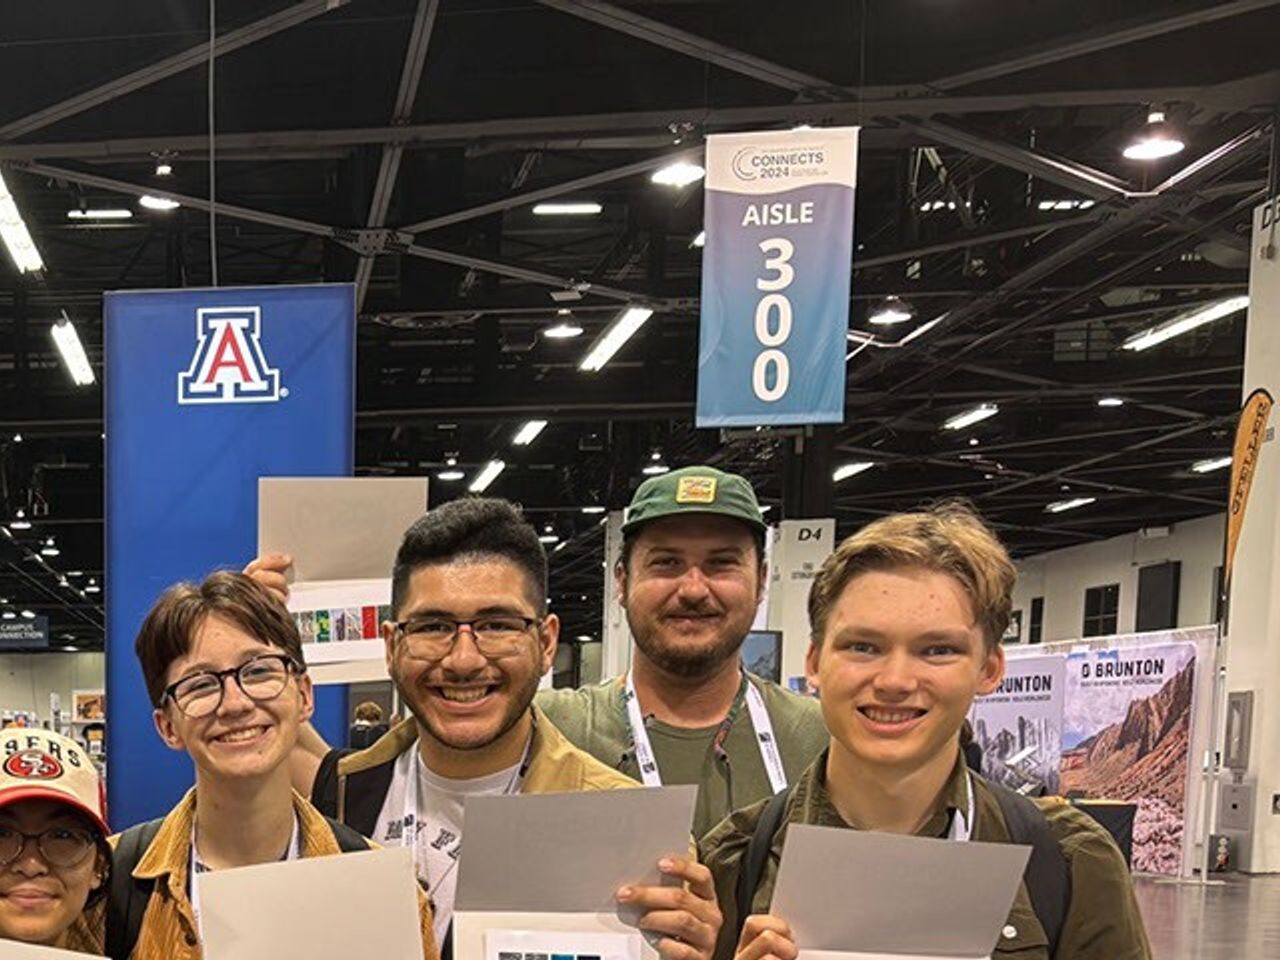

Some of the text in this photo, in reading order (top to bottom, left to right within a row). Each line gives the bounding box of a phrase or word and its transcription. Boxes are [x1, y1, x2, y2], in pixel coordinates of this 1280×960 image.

[751, 152, 823, 167] CONNECTS
[760, 167, 789, 179] 2024
[742, 202, 814, 227] AISLE
[752, 238, 795, 402] 300
[798, 527, 823, 541] D4
[1095, 659, 1165, 677] BRUNTON
[996, 675, 1052, 693] RUNTON
